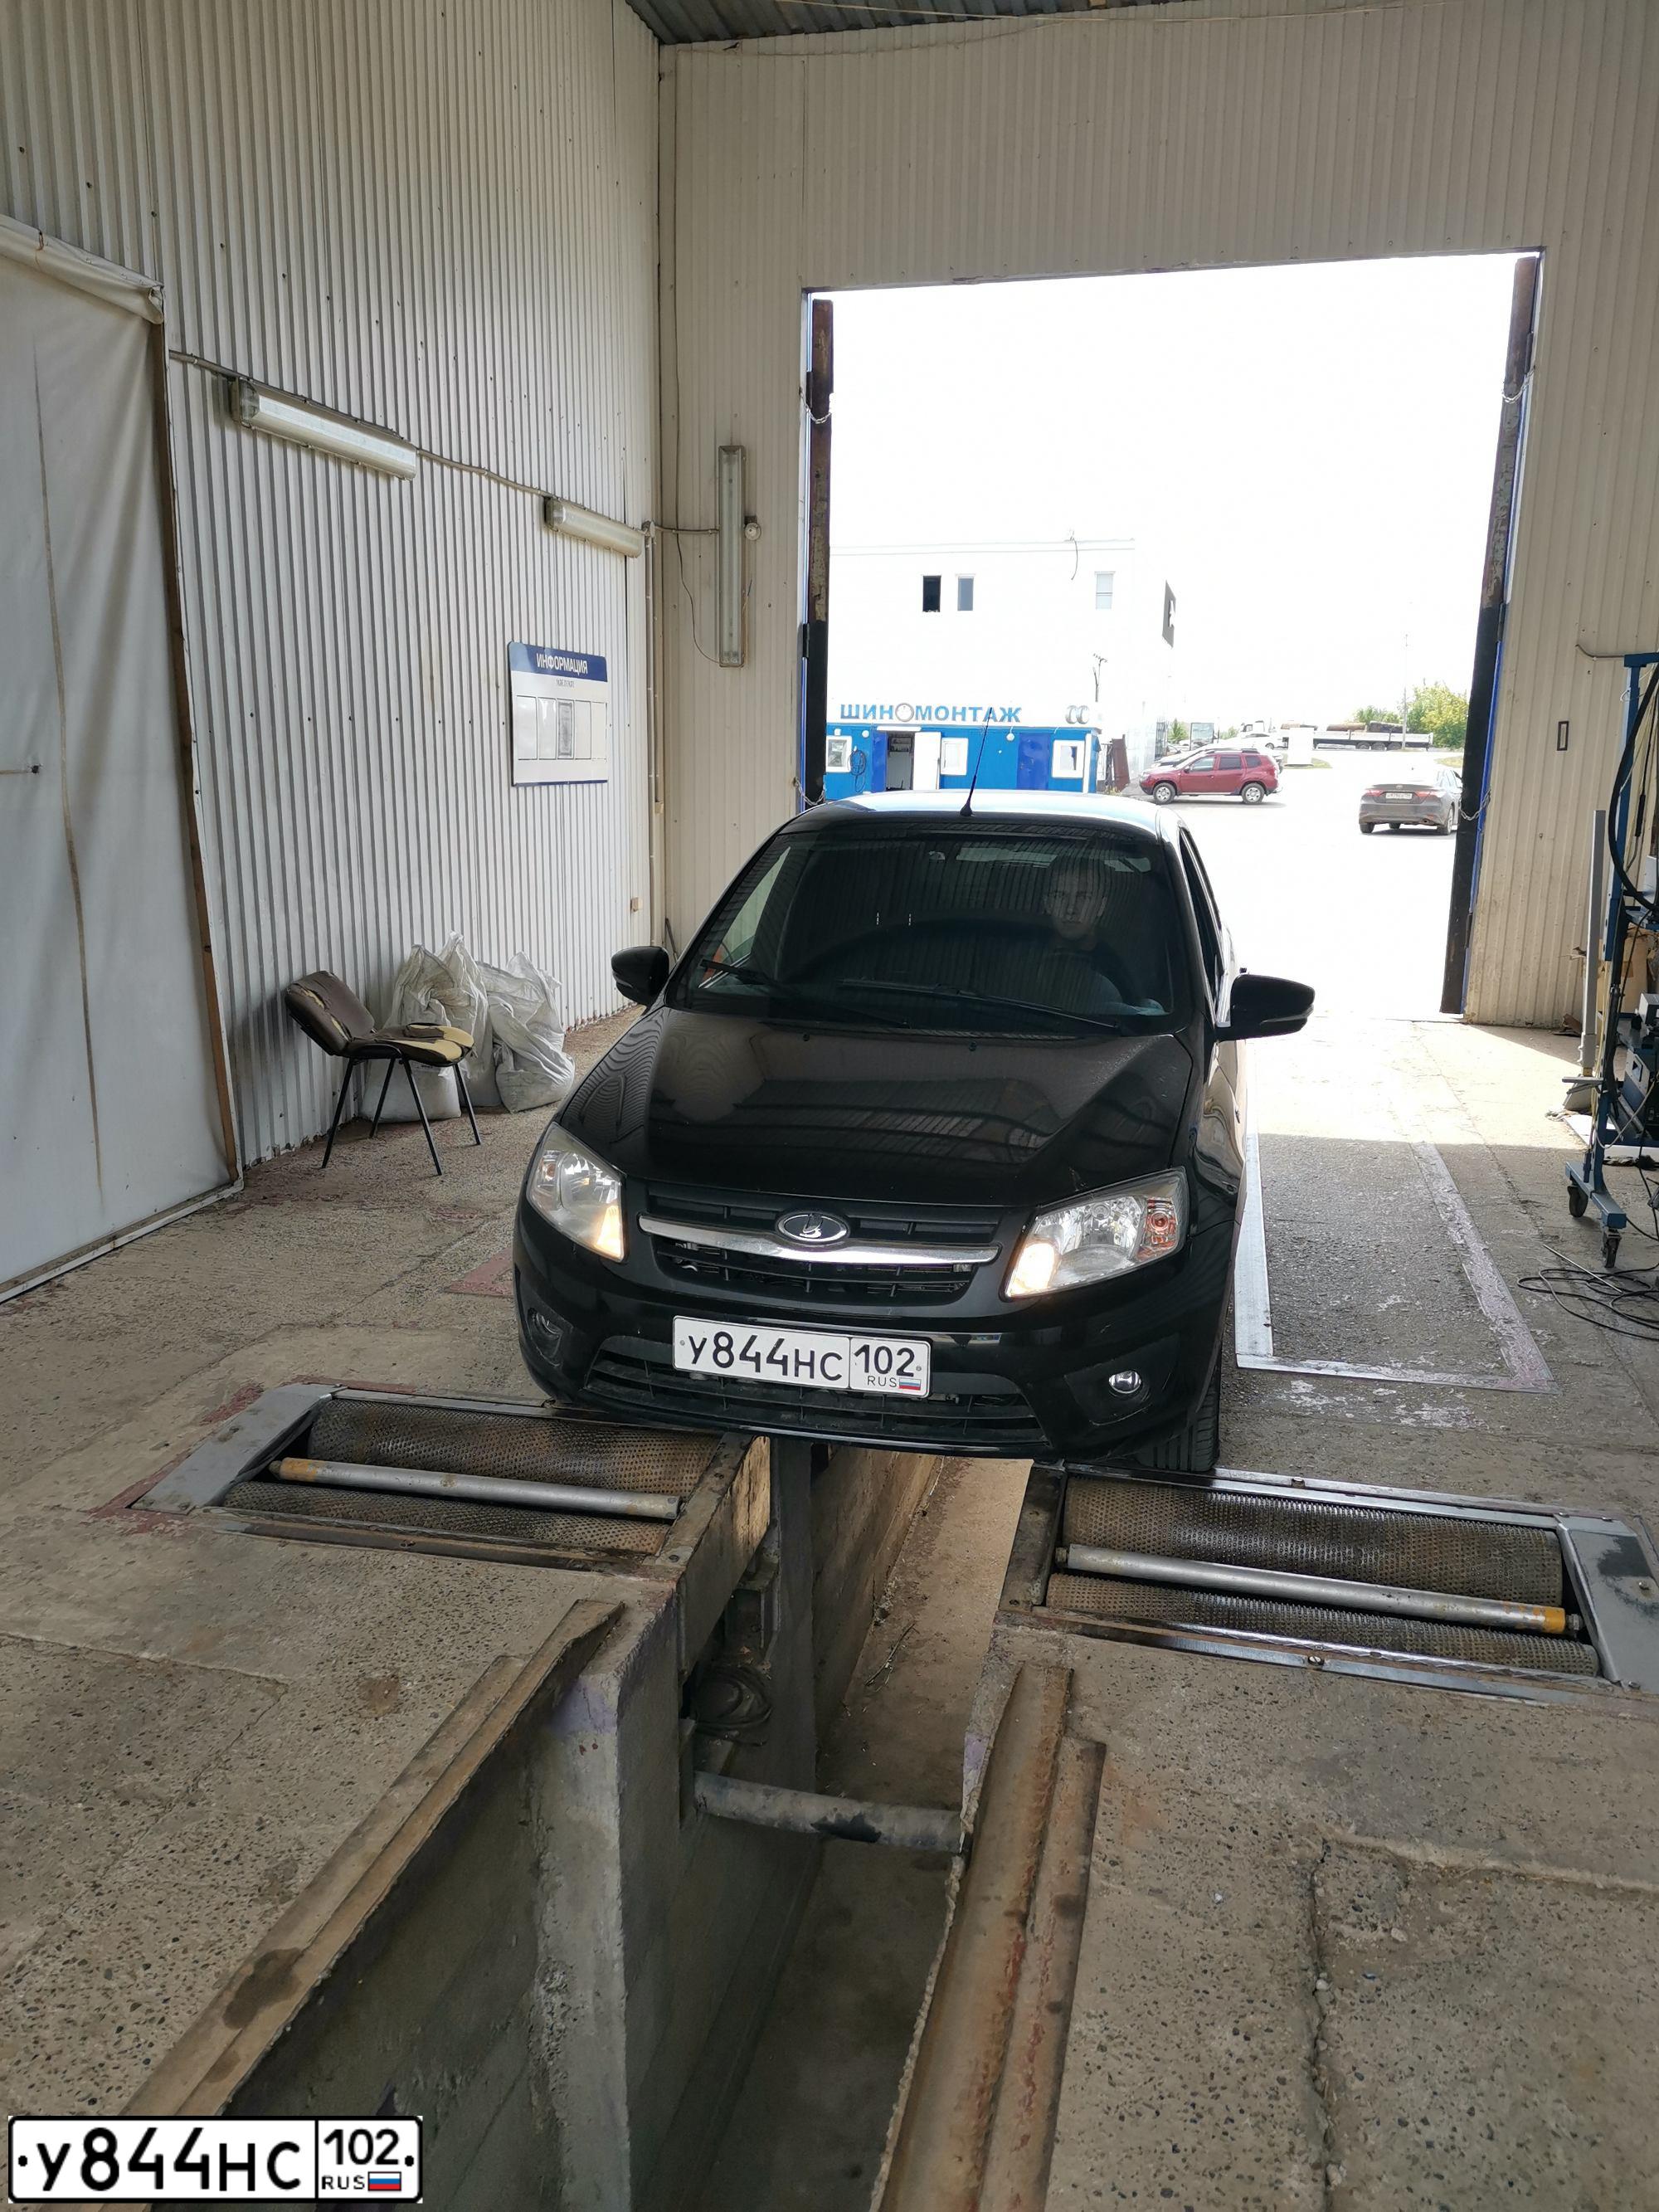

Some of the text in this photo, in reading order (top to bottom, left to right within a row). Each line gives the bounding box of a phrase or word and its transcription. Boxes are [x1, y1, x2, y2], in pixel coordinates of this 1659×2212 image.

[536, 653, 588, 675] ИНФОРМАЦИЯ
[839, 703, 1022, 723] ШИНОМОНТАЖ
[688, 1331, 916, 1381] У844НС 102
[867, 1375, 898, 1388] RUS
